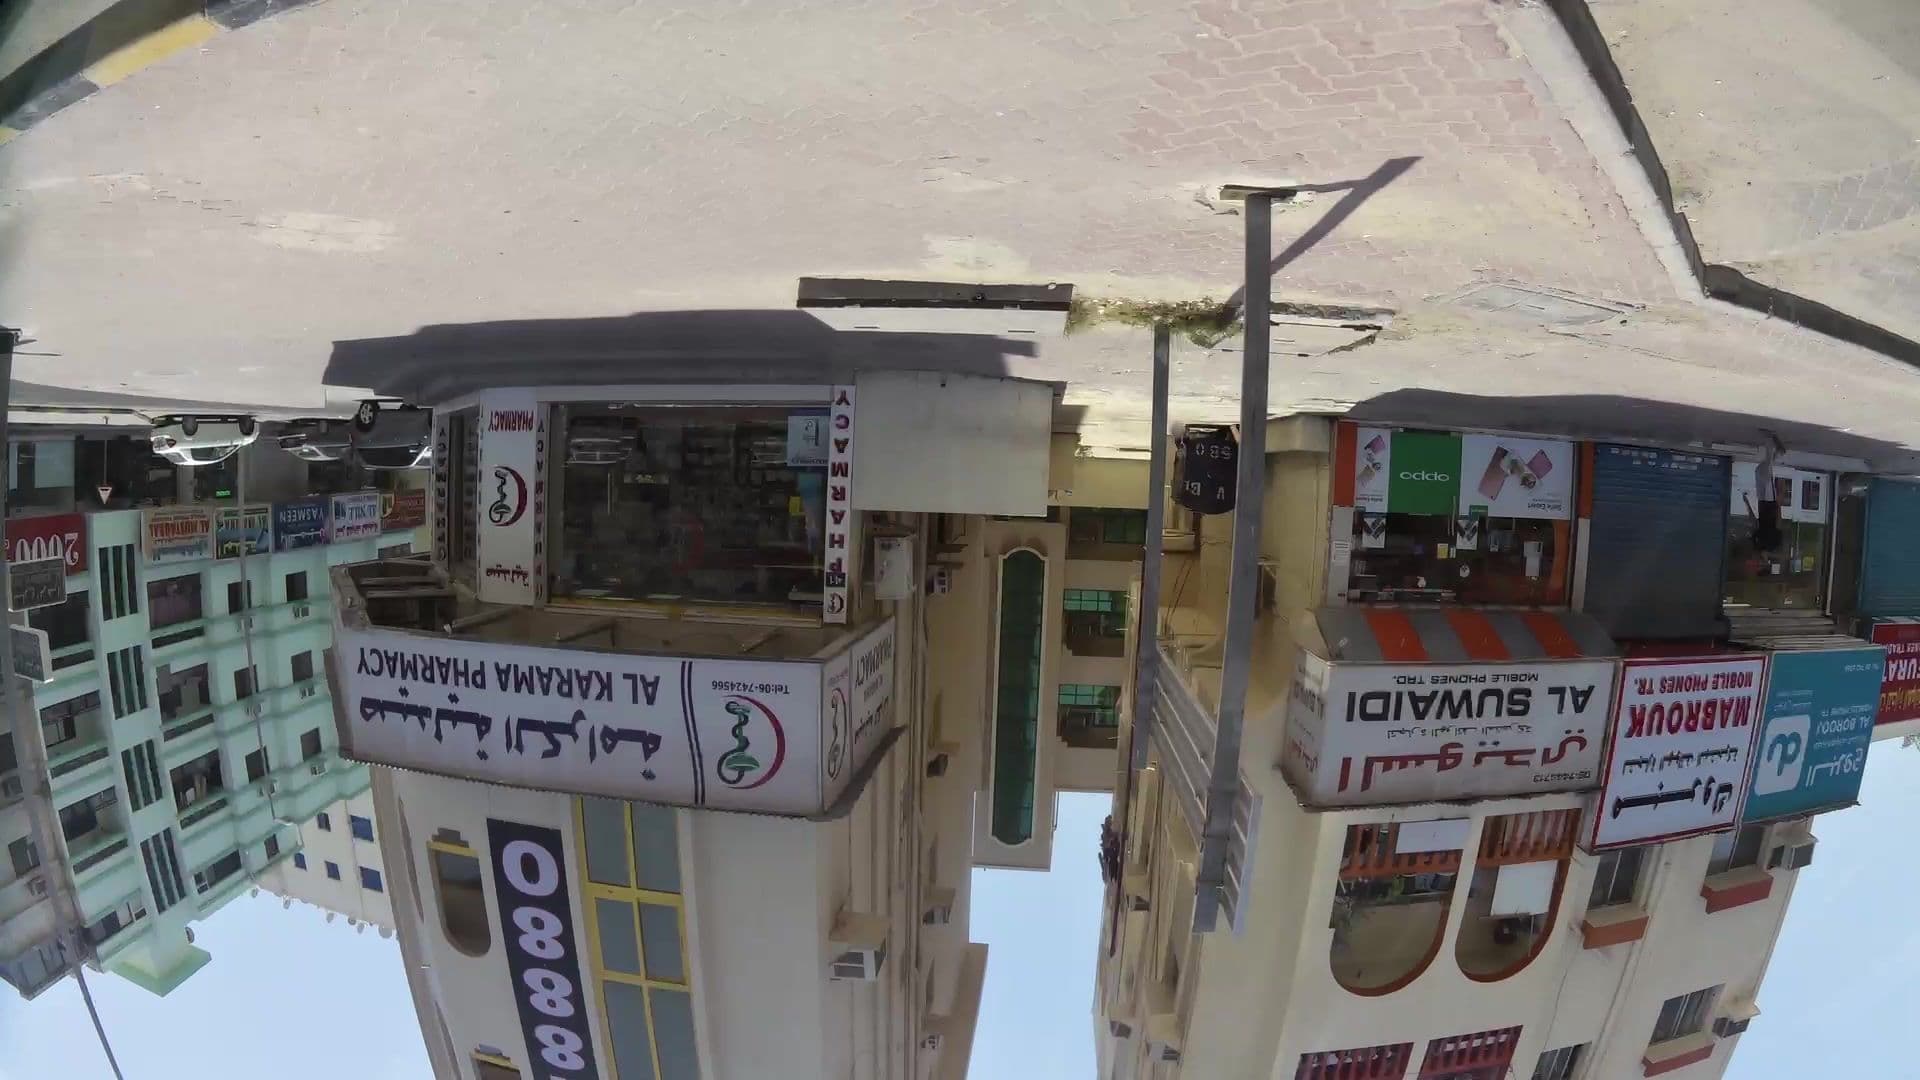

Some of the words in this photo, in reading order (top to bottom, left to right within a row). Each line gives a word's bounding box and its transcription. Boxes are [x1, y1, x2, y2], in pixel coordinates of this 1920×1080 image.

[488, 410, 534, 432] PHARMACY
[828, 390, 850, 573] PHARMACY
[1400, 470, 1450, 482] oppo
[279, 507, 324, 522] YASMEEN
[15, 532, 79, 565] 2000
[486, 565, 529, 587] صيدلية
[357, 647, 486, 692] PHARMACY
[494, 661, 613, 702] KARAMA
[1393, 675, 1424, 685] TRD.
[1431, 674, 1486, 684] PHONES
[1491, 672, 1539, 683] MOBILE
[1712, 672, 1753, 689] MOBILE
[622, 672, 660, 706] AL
[712, 679, 790, 695] Tel:06-7424566
[1634, 678, 1654, 695] TR.
[1660, 675, 1708, 693] PHONES
[1345, 688, 1532, 722] SUWAIDI
[1548, 686, 1595, 715] AL
[1624, 696, 1751, 738] MABROUK
[1860, 715, 1870, 728] AL
[360, 685, 492, 762] صيدلية
[506, 710, 662, 781] الكرامة
[1338, 730, 1587, 793] السويدي
[1767, 732, 1801, 777] du
[1612, 776, 1733, 819] مبروك
